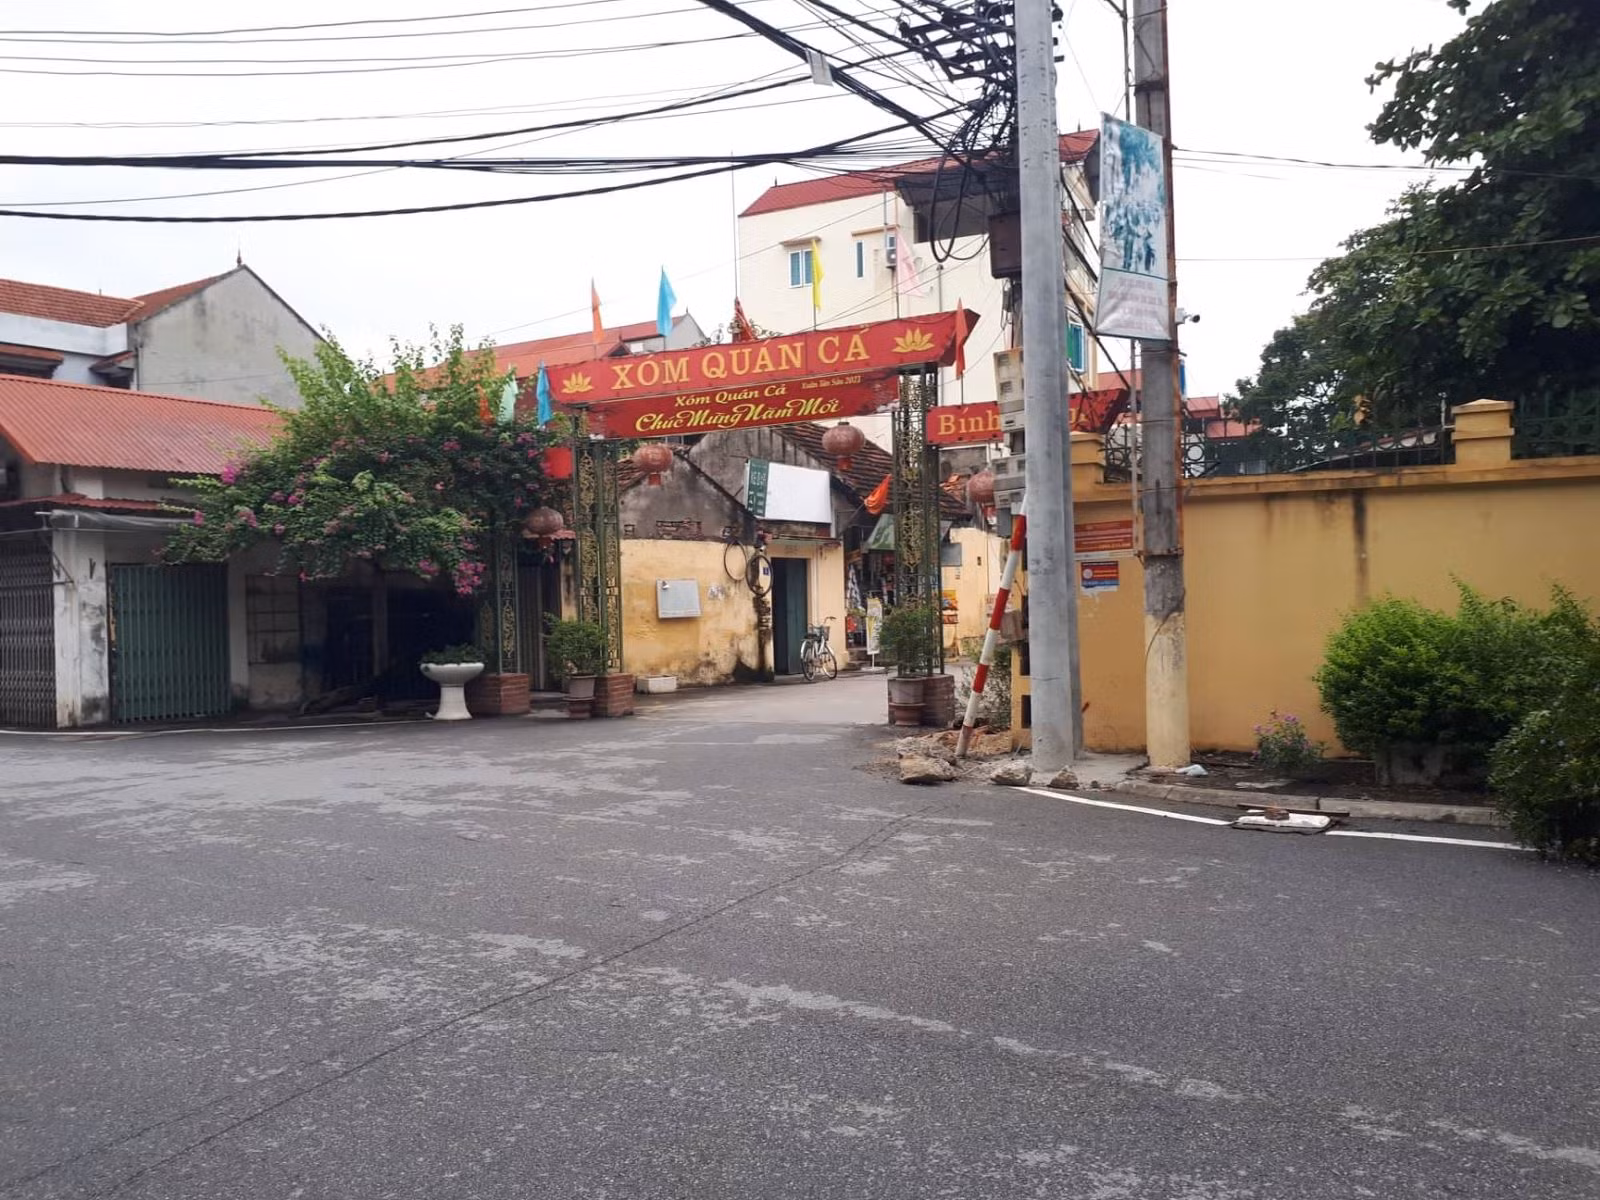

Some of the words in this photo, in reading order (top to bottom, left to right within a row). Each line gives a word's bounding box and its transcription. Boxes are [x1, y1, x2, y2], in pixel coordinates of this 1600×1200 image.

[611, 354, 690, 390] XÓM
[702, 340, 804, 378] QUÁN
[635, 413, 683, 432] Chúc
[732, 403, 793, 421] Năm
[785, 397, 840, 416] Mới
[674, 395, 710, 407] Xóm
[715, 389, 759, 404] Quán
